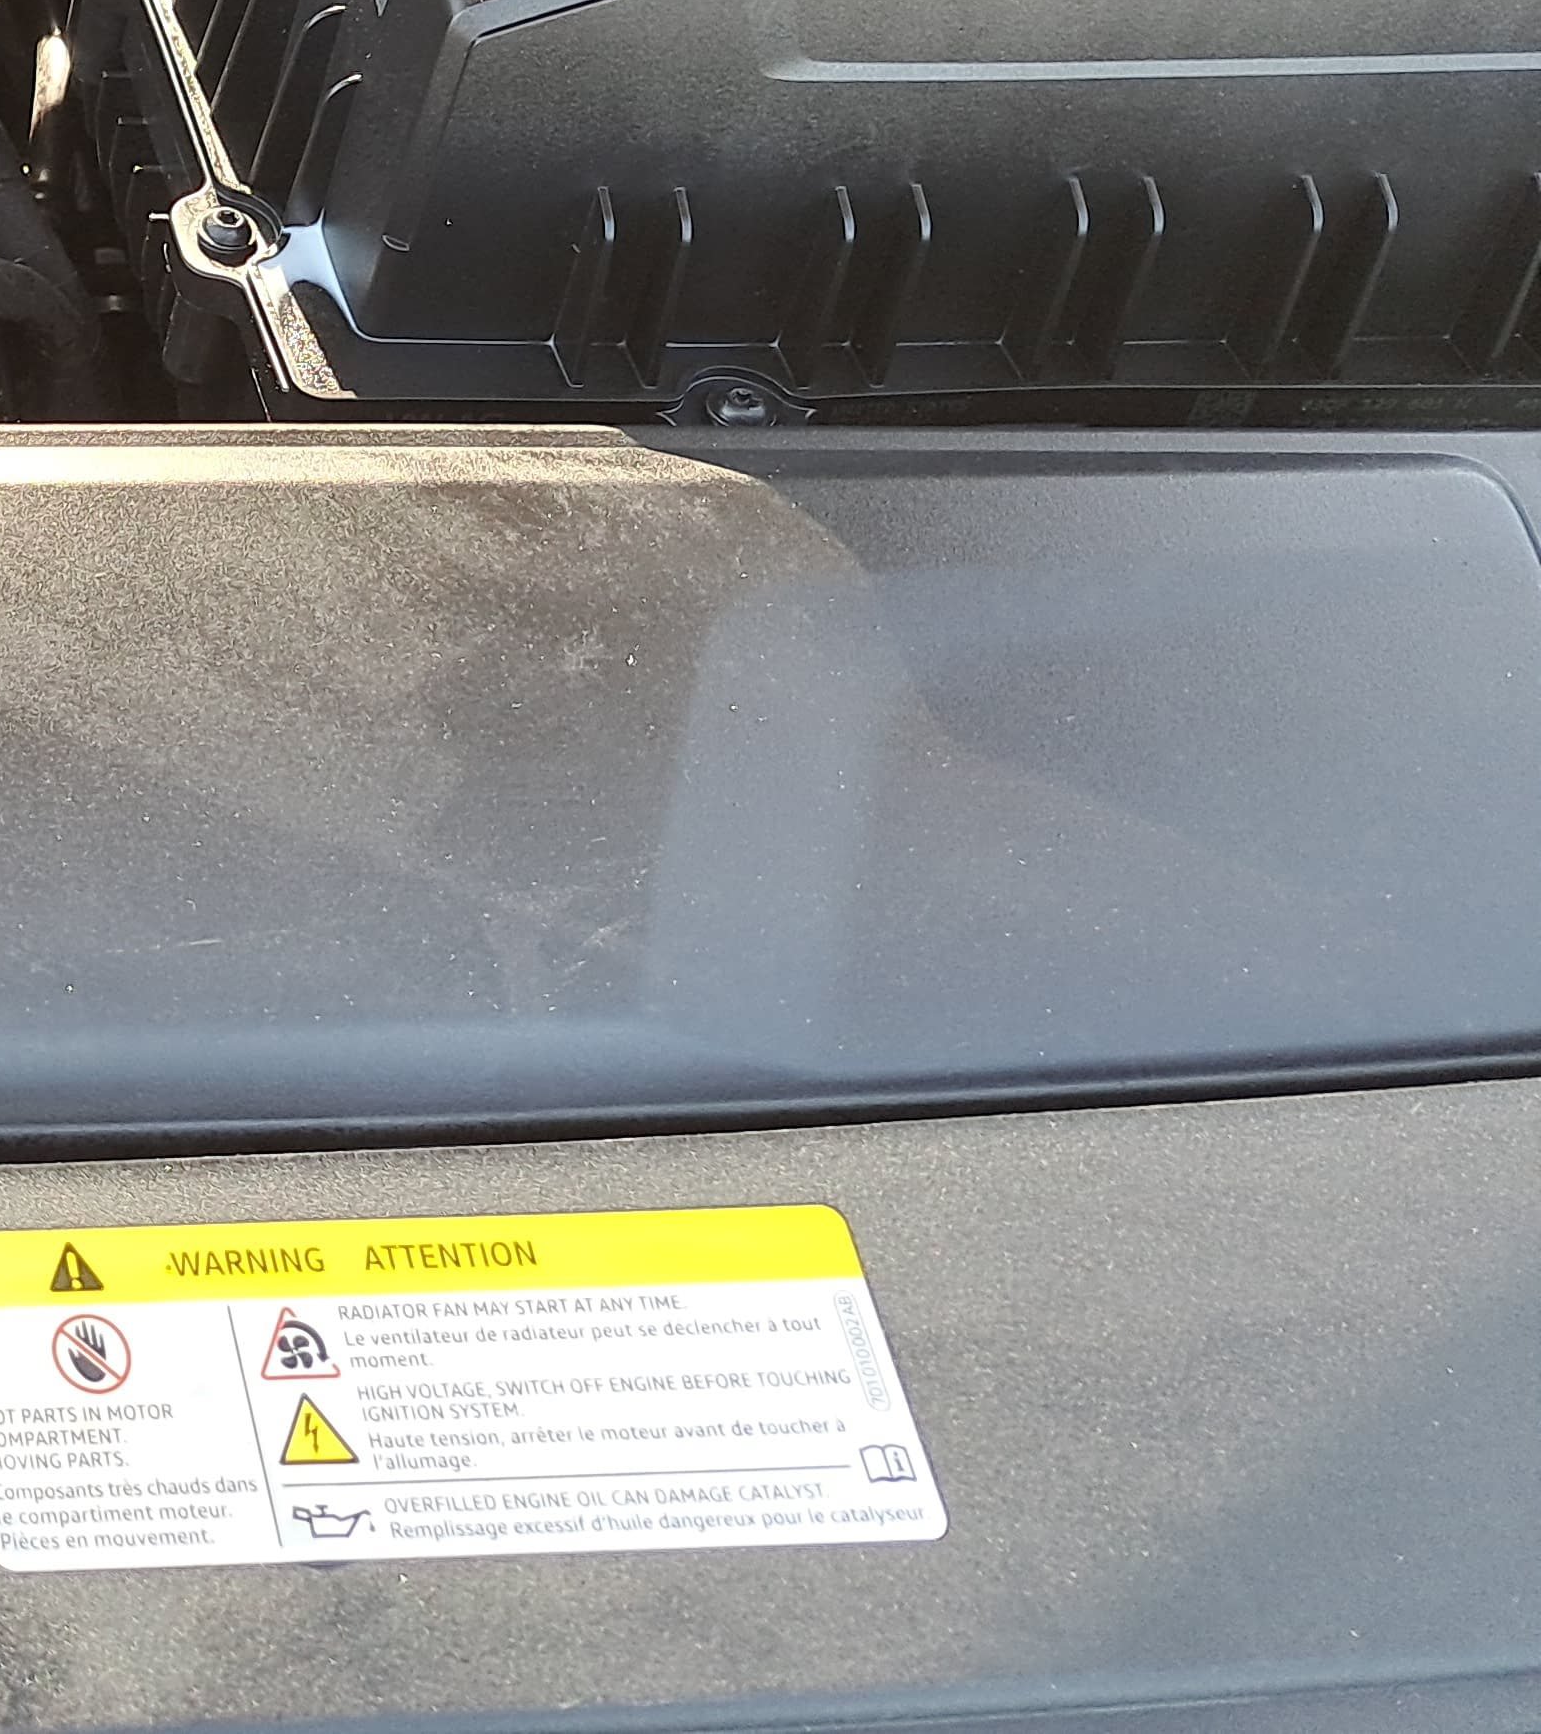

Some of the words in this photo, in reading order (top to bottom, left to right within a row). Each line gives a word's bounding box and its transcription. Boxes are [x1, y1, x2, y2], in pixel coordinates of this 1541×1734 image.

[169, 1247, 325, 1277] WARNING
[365, 1240, 537, 1271] ATTENTION
[338, 1303, 429, 1320] RADIATOR
[432, 1302, 468, 1318] FAN
[473, 1301, 508, 1316] MAY
[515, 1298, 567, 1315] START
[575, 1298, 592, 1313] AT
[600, 1298, 632, 1312] ANY
[344, 1331, 365, 1346] Le
[370, 1328, 468, 1346] ventilateur
[475, 1326, 497, 1342] de
[502, 1325, 584, 1341] radiateur
[591, 1324, 633, 1342] peut
[638, 1325, 657, 1337] se
[782, 1317, 821, 1332] tout
[350, 1353, 433, 1368] moment.
[357, 1384, 402, 1401] HIGH
[406, 1381, 492, 1399] VOLTAGE,
[495, 1379, 565, 1396] SWITCH
[570, 1378, 603, 1394] OFF
[609, 1375, 677, 1392] ENGINE
[681, 1373, 752, 1390] BEFORE
[757, 1369, 851, 1387] TOUCHING
[21, 1406, 77, 1424] PARTS
[82, 1406, 101, 1422] IN
[107, 1403, 173, 1421] MOTOR
[362, 1404, 445, 1422] IGNITION
[368, 1432, 425, 1449] Haute
[430, 1431, 505, 1447] tension,
[511, 1426, 571, 1444] arrêter
[578, 1426, 594, 1442] le
[601, 1426, 667, 1440] moteur
[674, 1423, 725, 1438] avant
[731, 1420, 754, 1436] de
[758, 1418, 828, 1436] toucher
[67, 1450, 129, 1468] PARTS.
[107, 1479, 143, 1498] très
[147, 1477, 211, 1496] chauds
[215, 1476, 258, 1493] dans
[384, 1494, 496, 1514] OVERFILLED
[502, 1491, 572, 1510] ENGINE
[577, 1491, 607, 1507] OIL
[611, 1490, 649, 1506] CAN
[654, 1486, 733, 1504] DAMAGE
[19, 1505, 154, 1528] compartiment
[159, 1504, 232, 1520] moteur.
[390, 1520, 508, 1542] Remplissage
[513, 1514, 585, 1535] excessif
[591, 1513, 653, 1532] d'huile
[658, 1513, 756, 1533] dangereux
[761, 1512, 802, 1529] pour
[808, 1508, 824, 1524] le
[0, 1531, 60, 1551] Pièces
[65, 1535, 89, 1549] en
[94, 1529, 215, 1547] mouvement.
